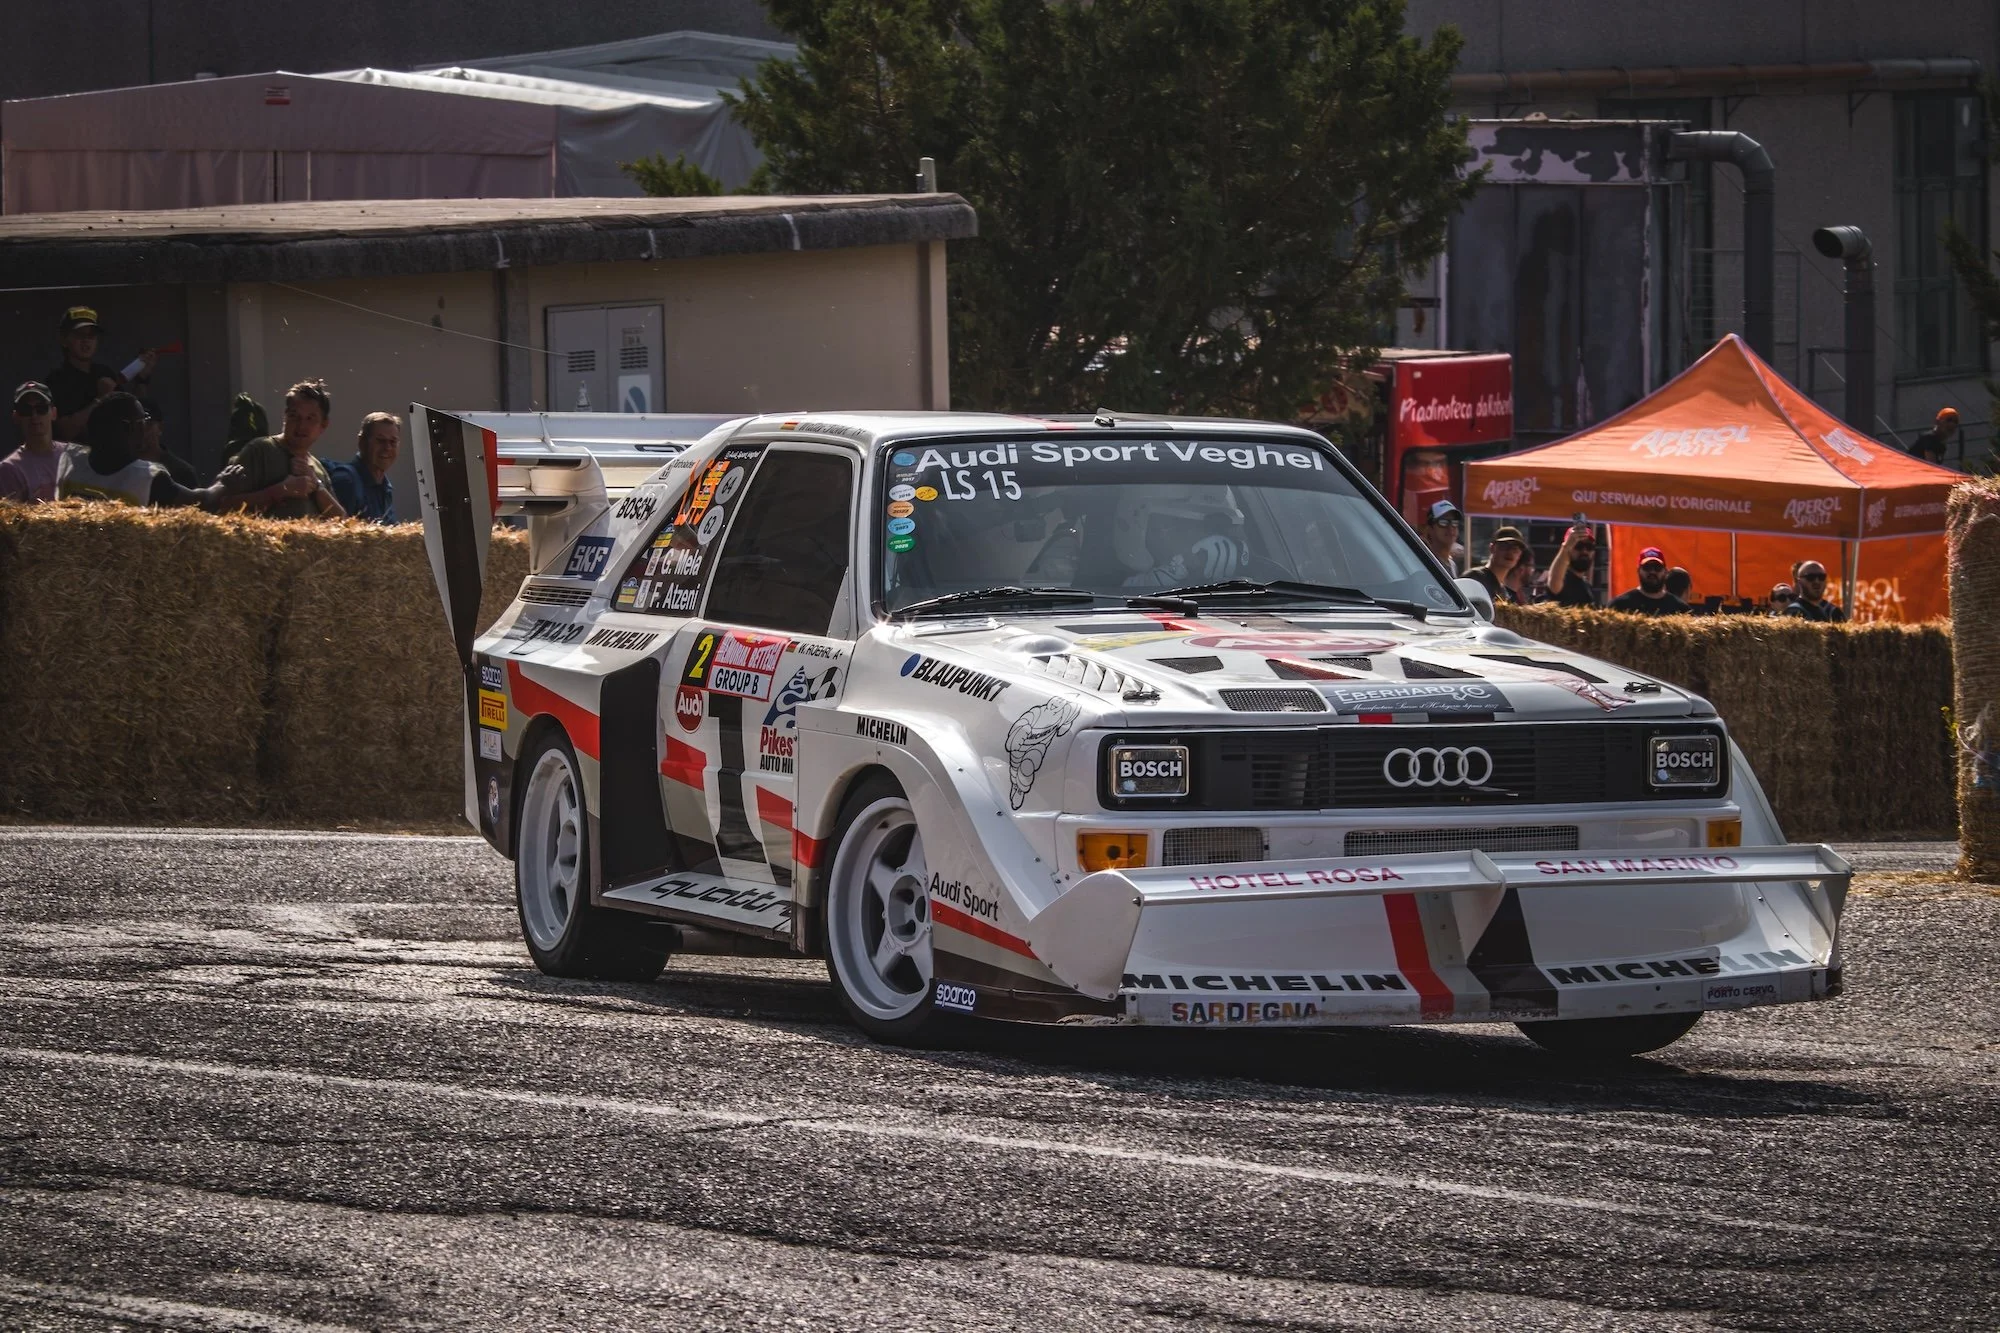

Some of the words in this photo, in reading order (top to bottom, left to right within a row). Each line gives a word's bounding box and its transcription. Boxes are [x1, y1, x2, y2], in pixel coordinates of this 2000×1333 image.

[1630, 425, 1751, 451] APEROL
[915, 443, 1019, 473] Audi
[1031, 442, 1160, 467] Sport
[1165, 441, 1324, 471] Veghel
[1643, 443, 1728, 459] SPRITZ
[722, 476, 738, 494] 64
[940, 470, 976, 500] LS
[982, 470, 1022, 500] 15
[1483, 477, 1540, 500] APEROL
[616, 497, 657, 520] BOSCH
[1572, 490, 1597, 503] QUI
[1600, 491, 1667, 508] SERVIAMO
[1670, 496, 1751, 513] L'ORIGINALE
[1784, 497, 1842, 519] APEROL
[704, 516, 717, 534] 62
[1792, 511, 1832, 528] SPRITZ
[568, 545, 609, 572] SKF
[661, 548, 674, 574] G.
[674, 549, 702, 575] Mela
[649, 582, 663, 608] F.
[662, 582, 700, 610] Atzeni
[585, 628, 659, 651] MICHELIN
[688, 634, 714, 678] 2
[481, 665, 501, 685] sparco
[715, 669, 750, 692] GROUP
[752, 675, 760, 694] B
[912, 658, 1012, 702] BLAUPUNKT
[677, 691, 703, 716] Audi
[1335, 685, 1456, 702] EBERHARD
[481, 697, 505, 722] PIRELLI
[760, 726, 793, 757] Pikes
[857, 716, 907, 745] MICHELIN
[760, 754, 780, 772] AUTO
[1120, 761, 1182, 777] BOSCH
[1656, 752, 1714, 768] BOSCH
[1535, 859, 1606, 875] SAN
[1609, 856, 1740, 873] MARINO
[1190, 872, 1303, 891] HOTEL
[1306, 867, 1404, 885] ROSA
[930, 872, 961, 904] Audi
[963, 885, 998, 921] Sport
[1547, 949, 1808, 985] MICHELIN
[1120, 973, 1407, 991] MICHELIN
[1707, 987, 1740, 999] PORTO
[1743, 984, 1775, 996] CERVO
[936, 983, 976, 1007] sparco
[1172, 1002, 1318, 1023] SARDEGNA
